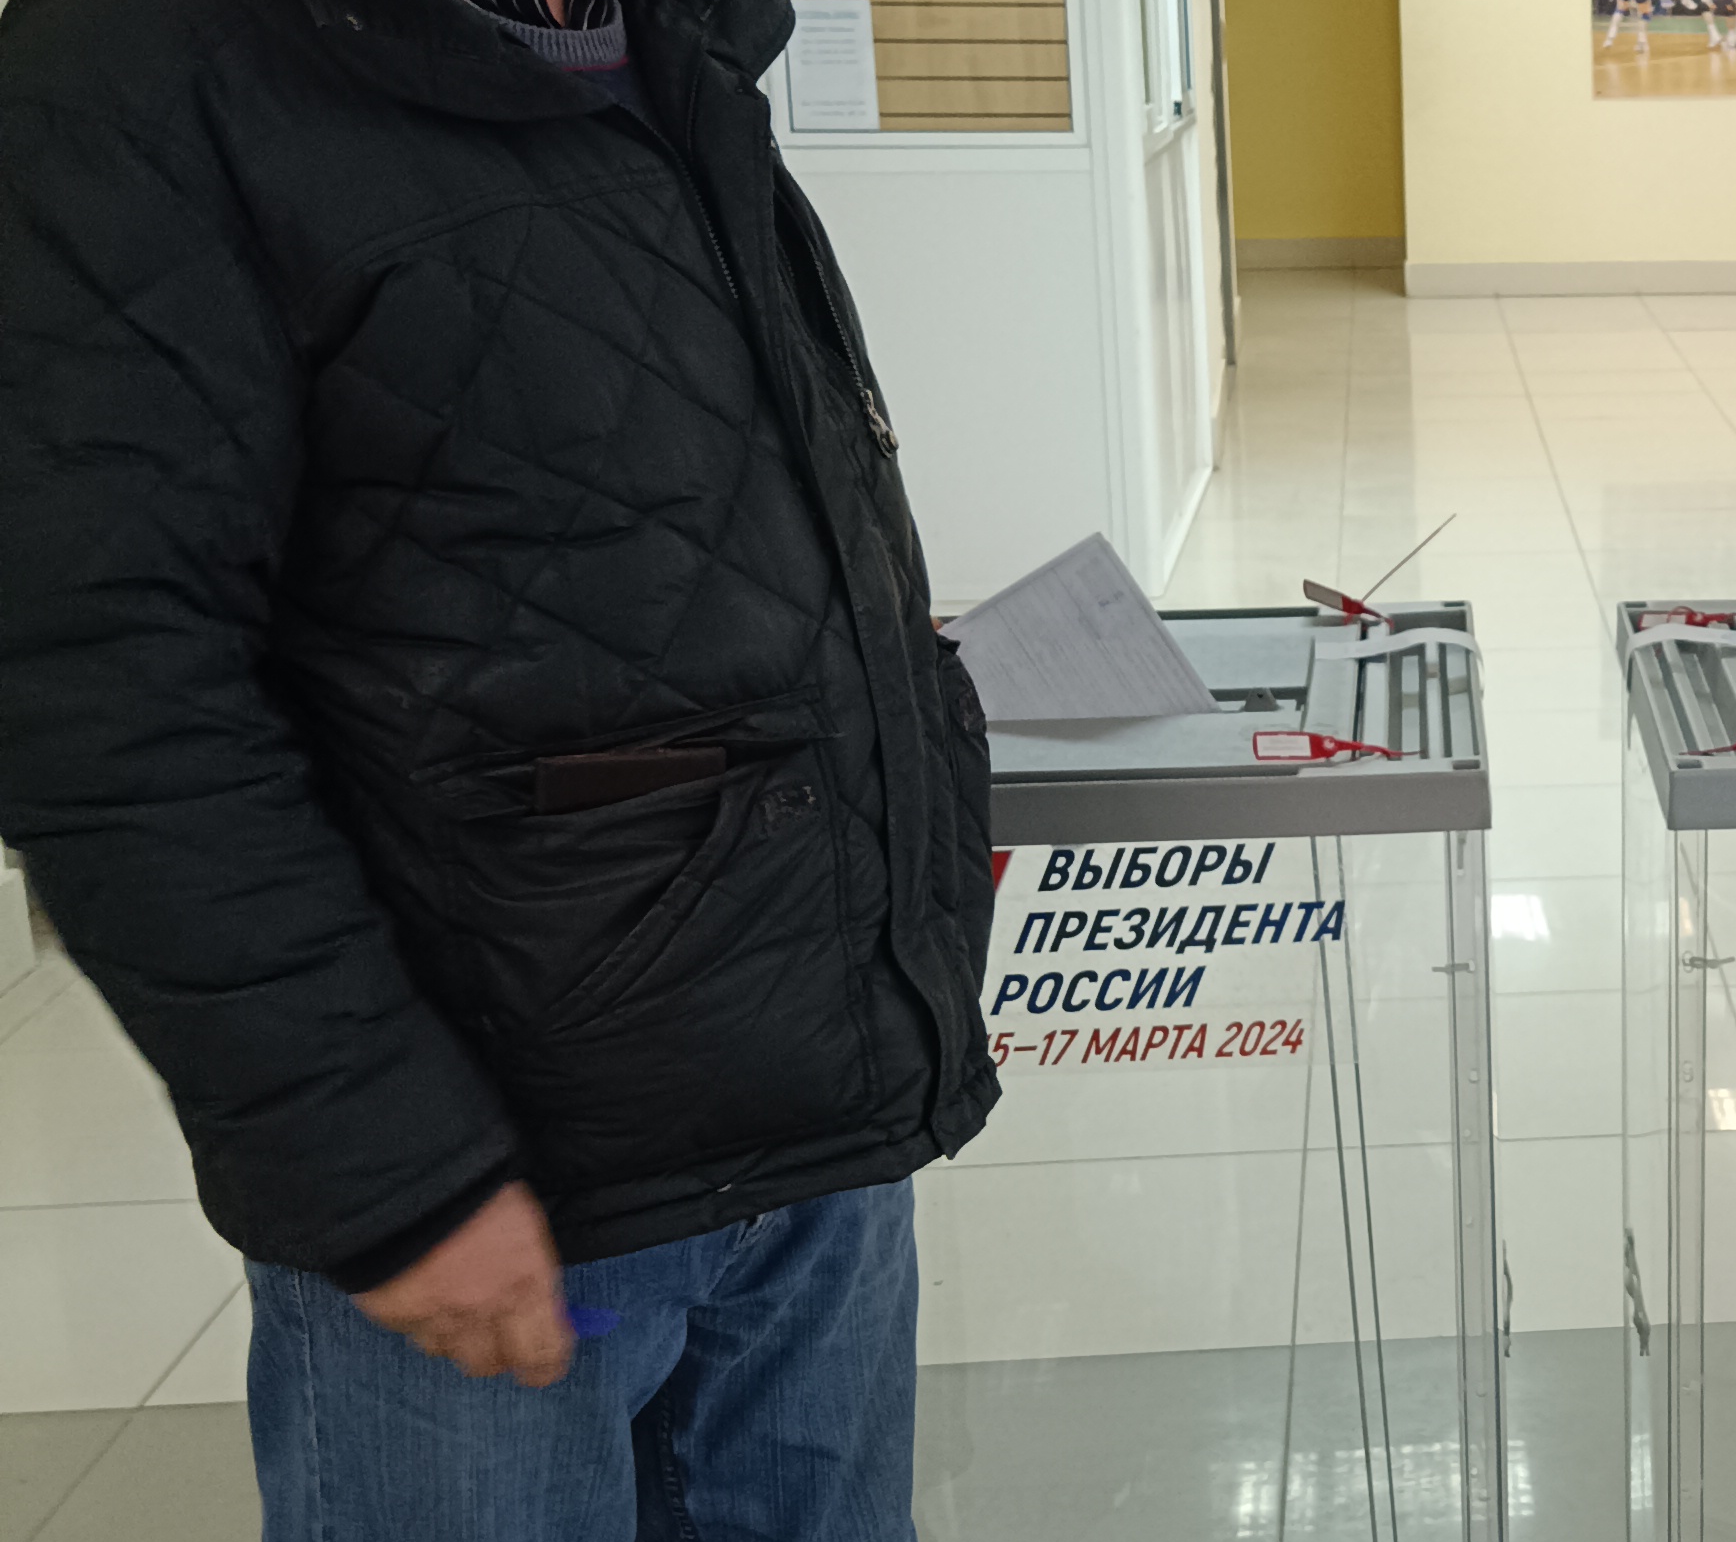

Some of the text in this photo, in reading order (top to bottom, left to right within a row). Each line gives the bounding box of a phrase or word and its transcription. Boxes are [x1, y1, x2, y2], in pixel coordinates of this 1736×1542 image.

[1037, 842, 1276, 892] ВЫБОРЫ
[1013, 899, 1346, 955] ПРЕЗИДЕНТА
[989, 965, 1206, 1016] РОССИИ
[1081, 1025, 1208, 1064] МАРТА
[1216, 1020, 1303, 1058] 2024
